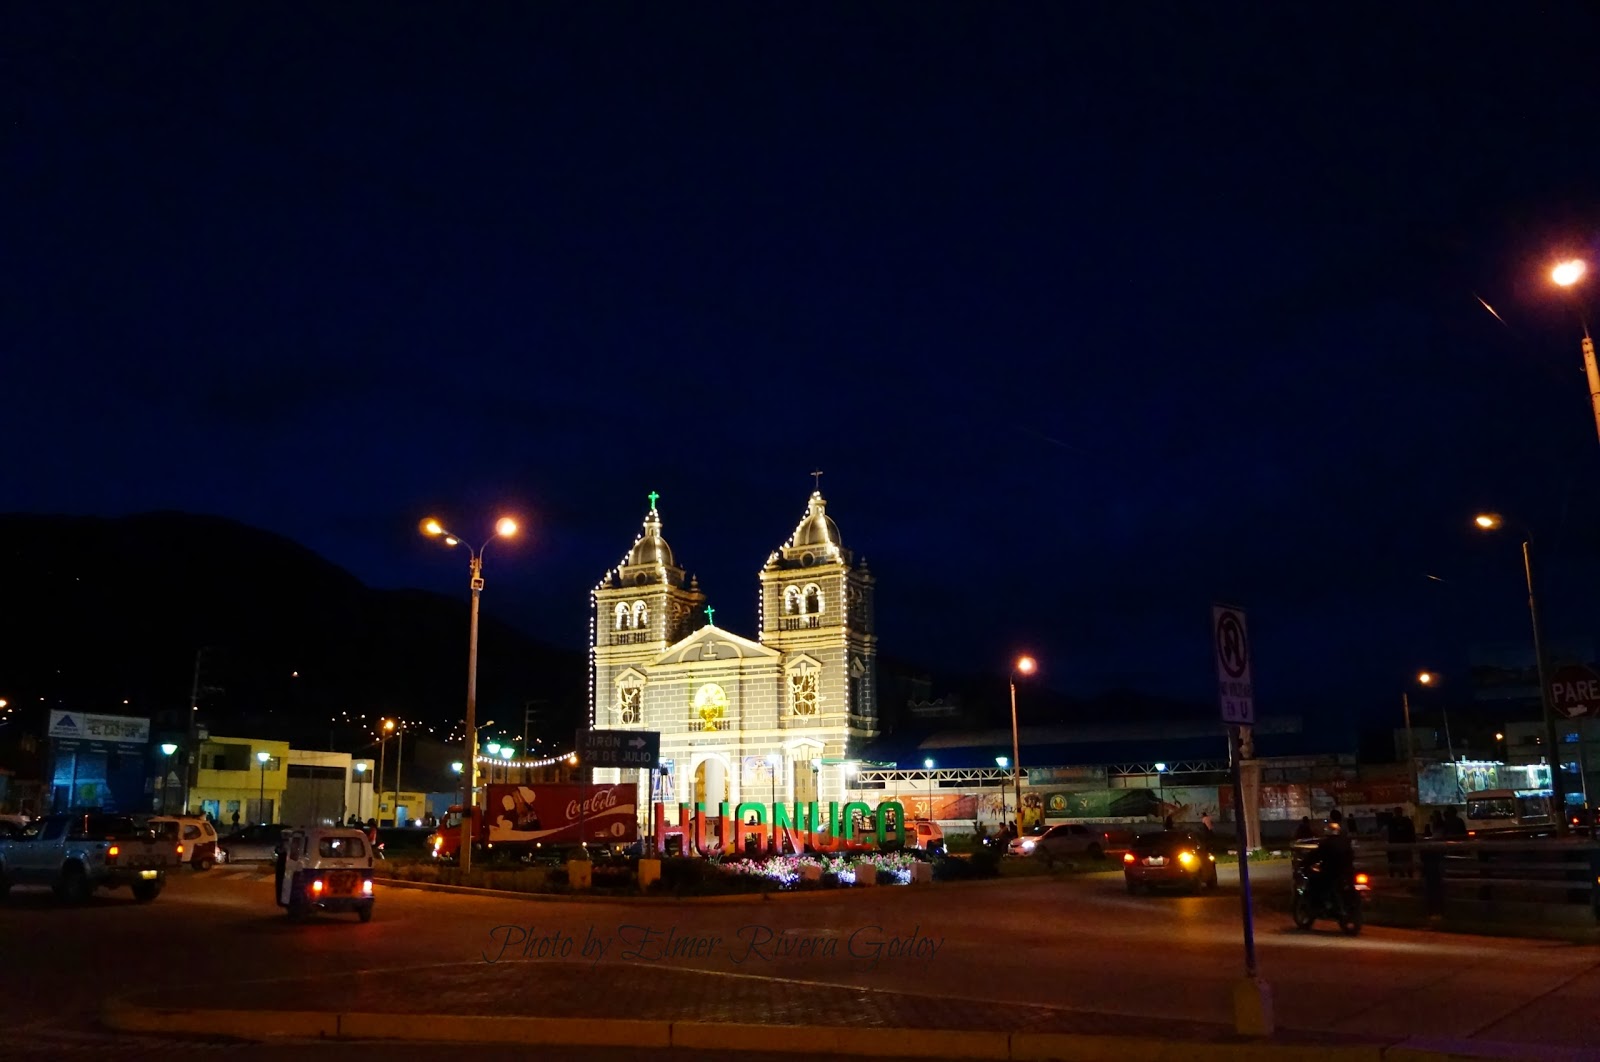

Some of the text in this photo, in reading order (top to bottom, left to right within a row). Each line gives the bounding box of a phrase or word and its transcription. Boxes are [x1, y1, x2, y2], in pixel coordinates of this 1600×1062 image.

[1552, 679, 1600, 703] PARE
[585, 733, 621, 748] JIRÓN
[602, 751, 618, 762] DE
[622, 751, 651, 763] JULIO
[653, 801, 906, 860] HUANUCO
